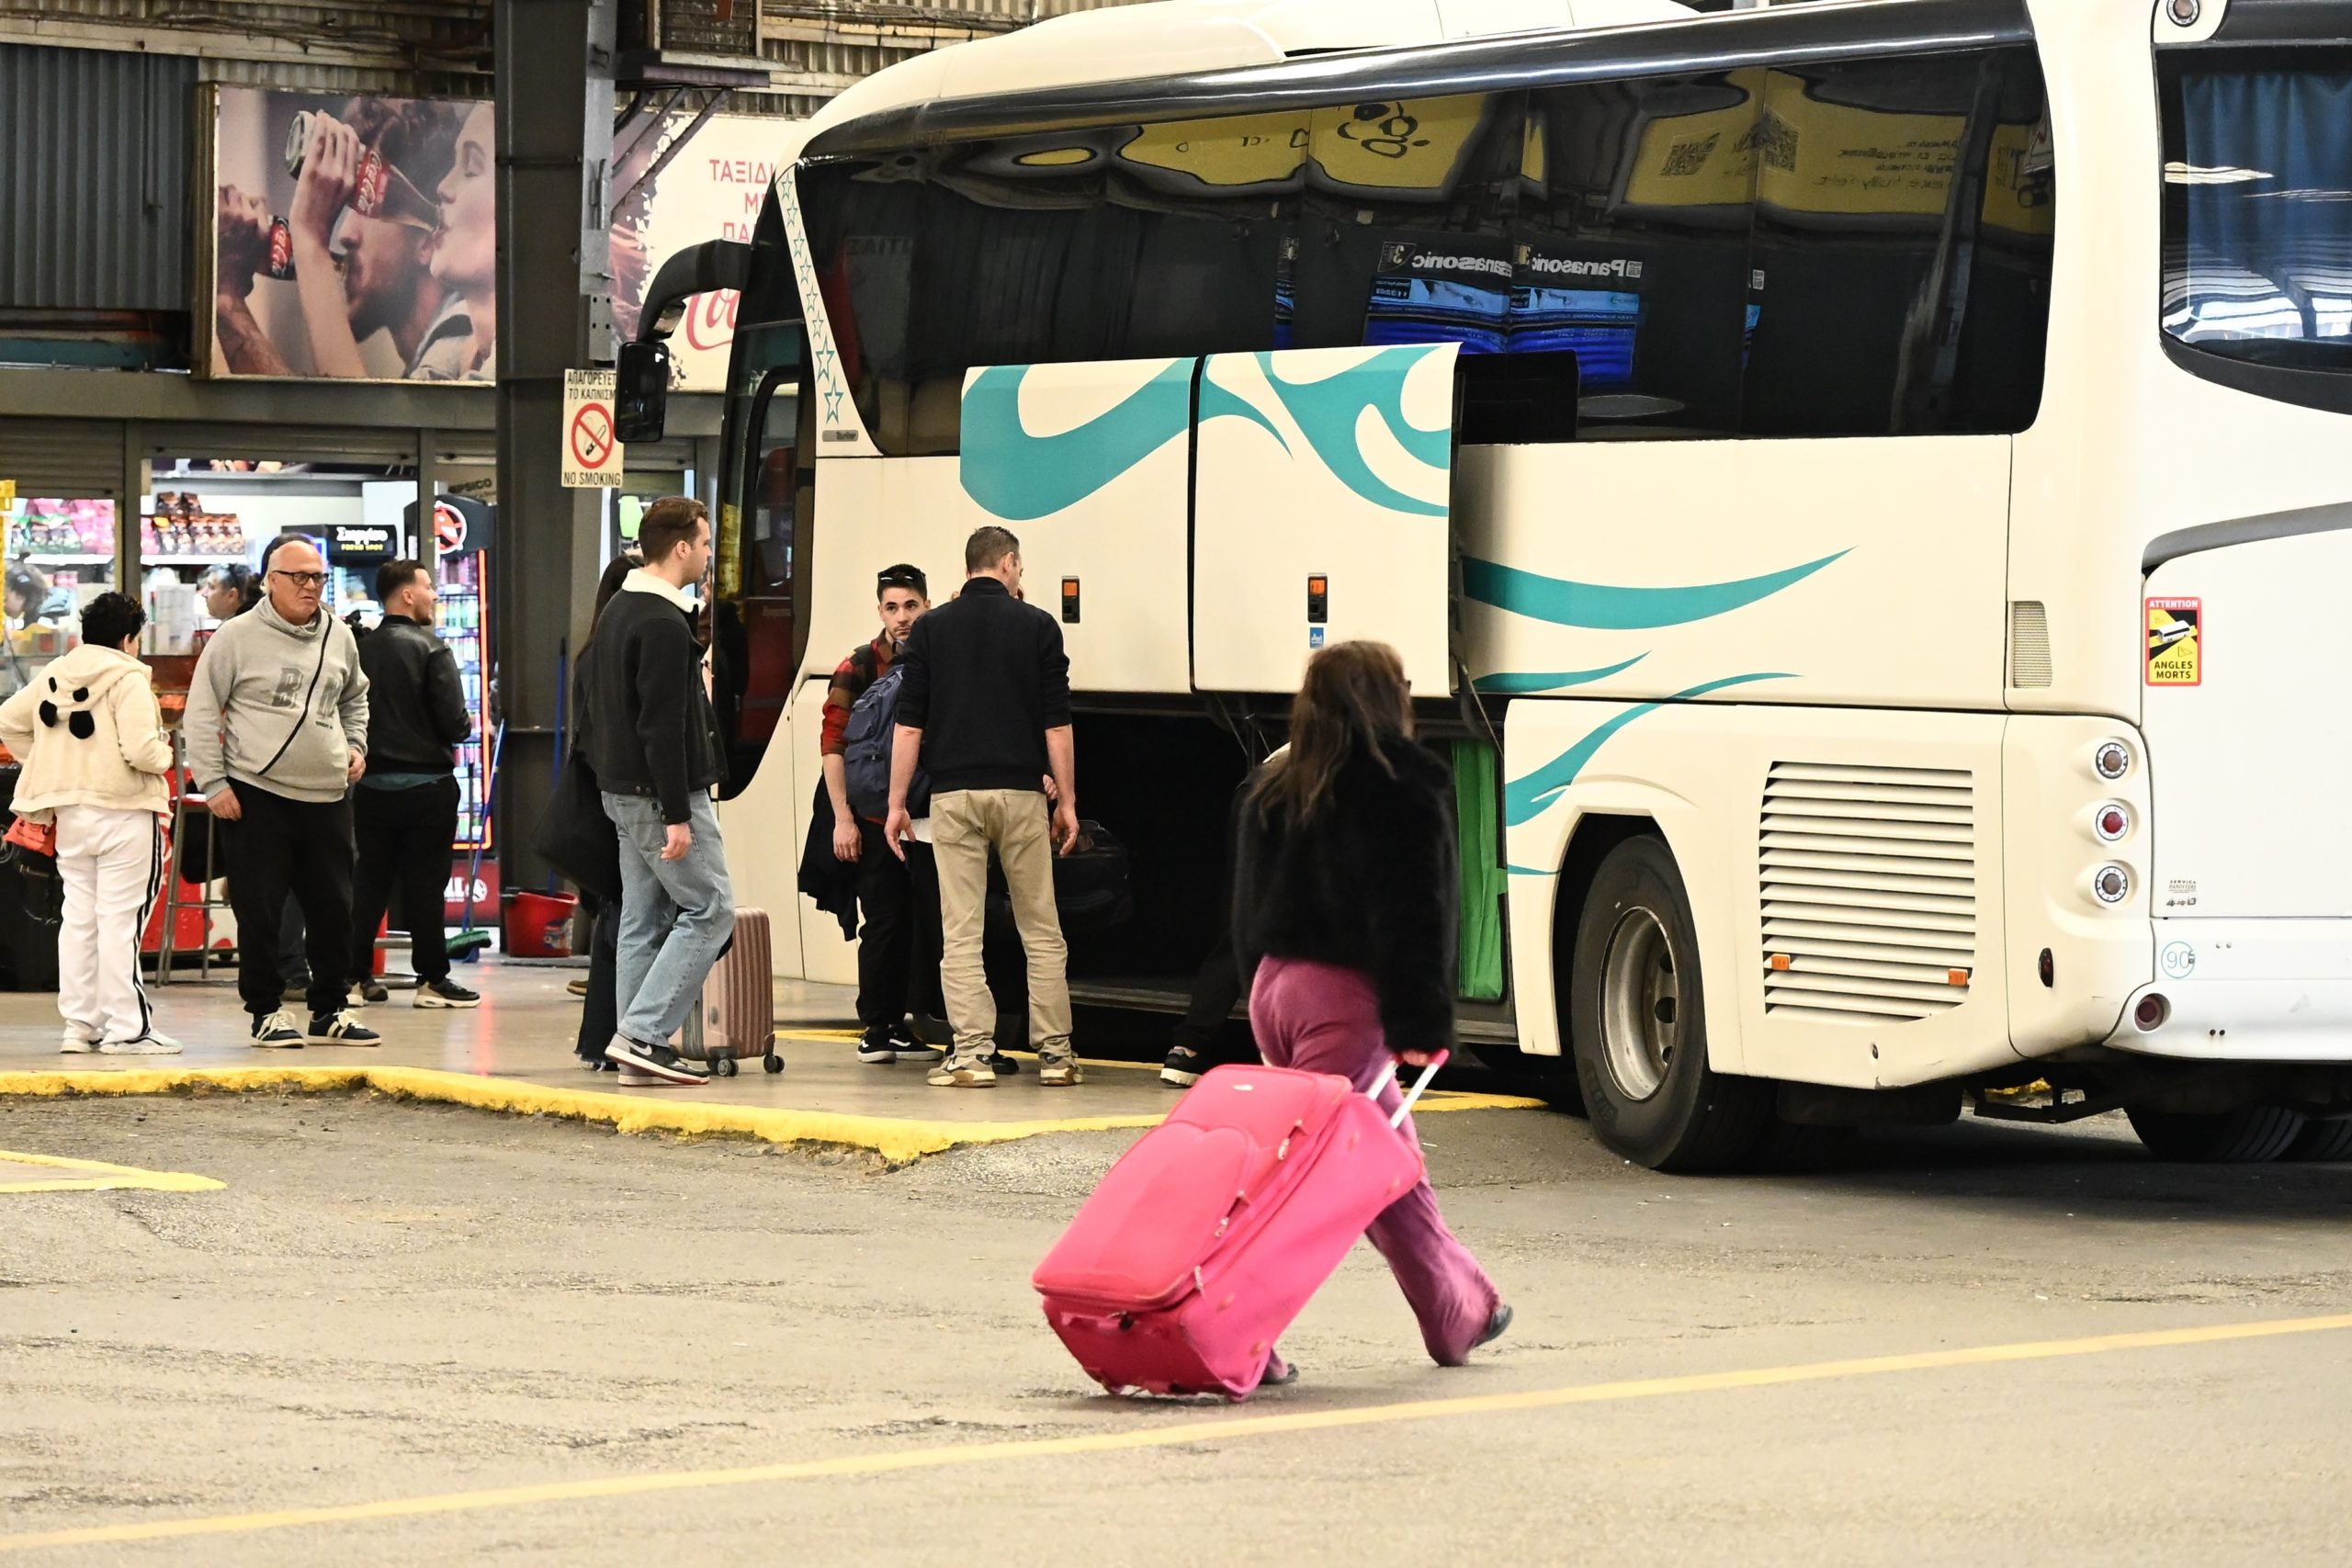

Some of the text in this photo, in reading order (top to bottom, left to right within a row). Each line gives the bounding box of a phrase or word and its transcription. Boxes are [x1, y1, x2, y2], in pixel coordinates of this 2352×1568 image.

[745, 192, 766, 214] Μ
[723, 221, 756, 243] ΠΑ
[563, 471, 621, 486] NO SMOKING
[2149, 600, 2198, 608] ATTENTION
[2154, 661, 2193, 670] ANGLES
[2156, 671, 2191, 679] MORTS
[2166, 951, 2190, 969] 90
